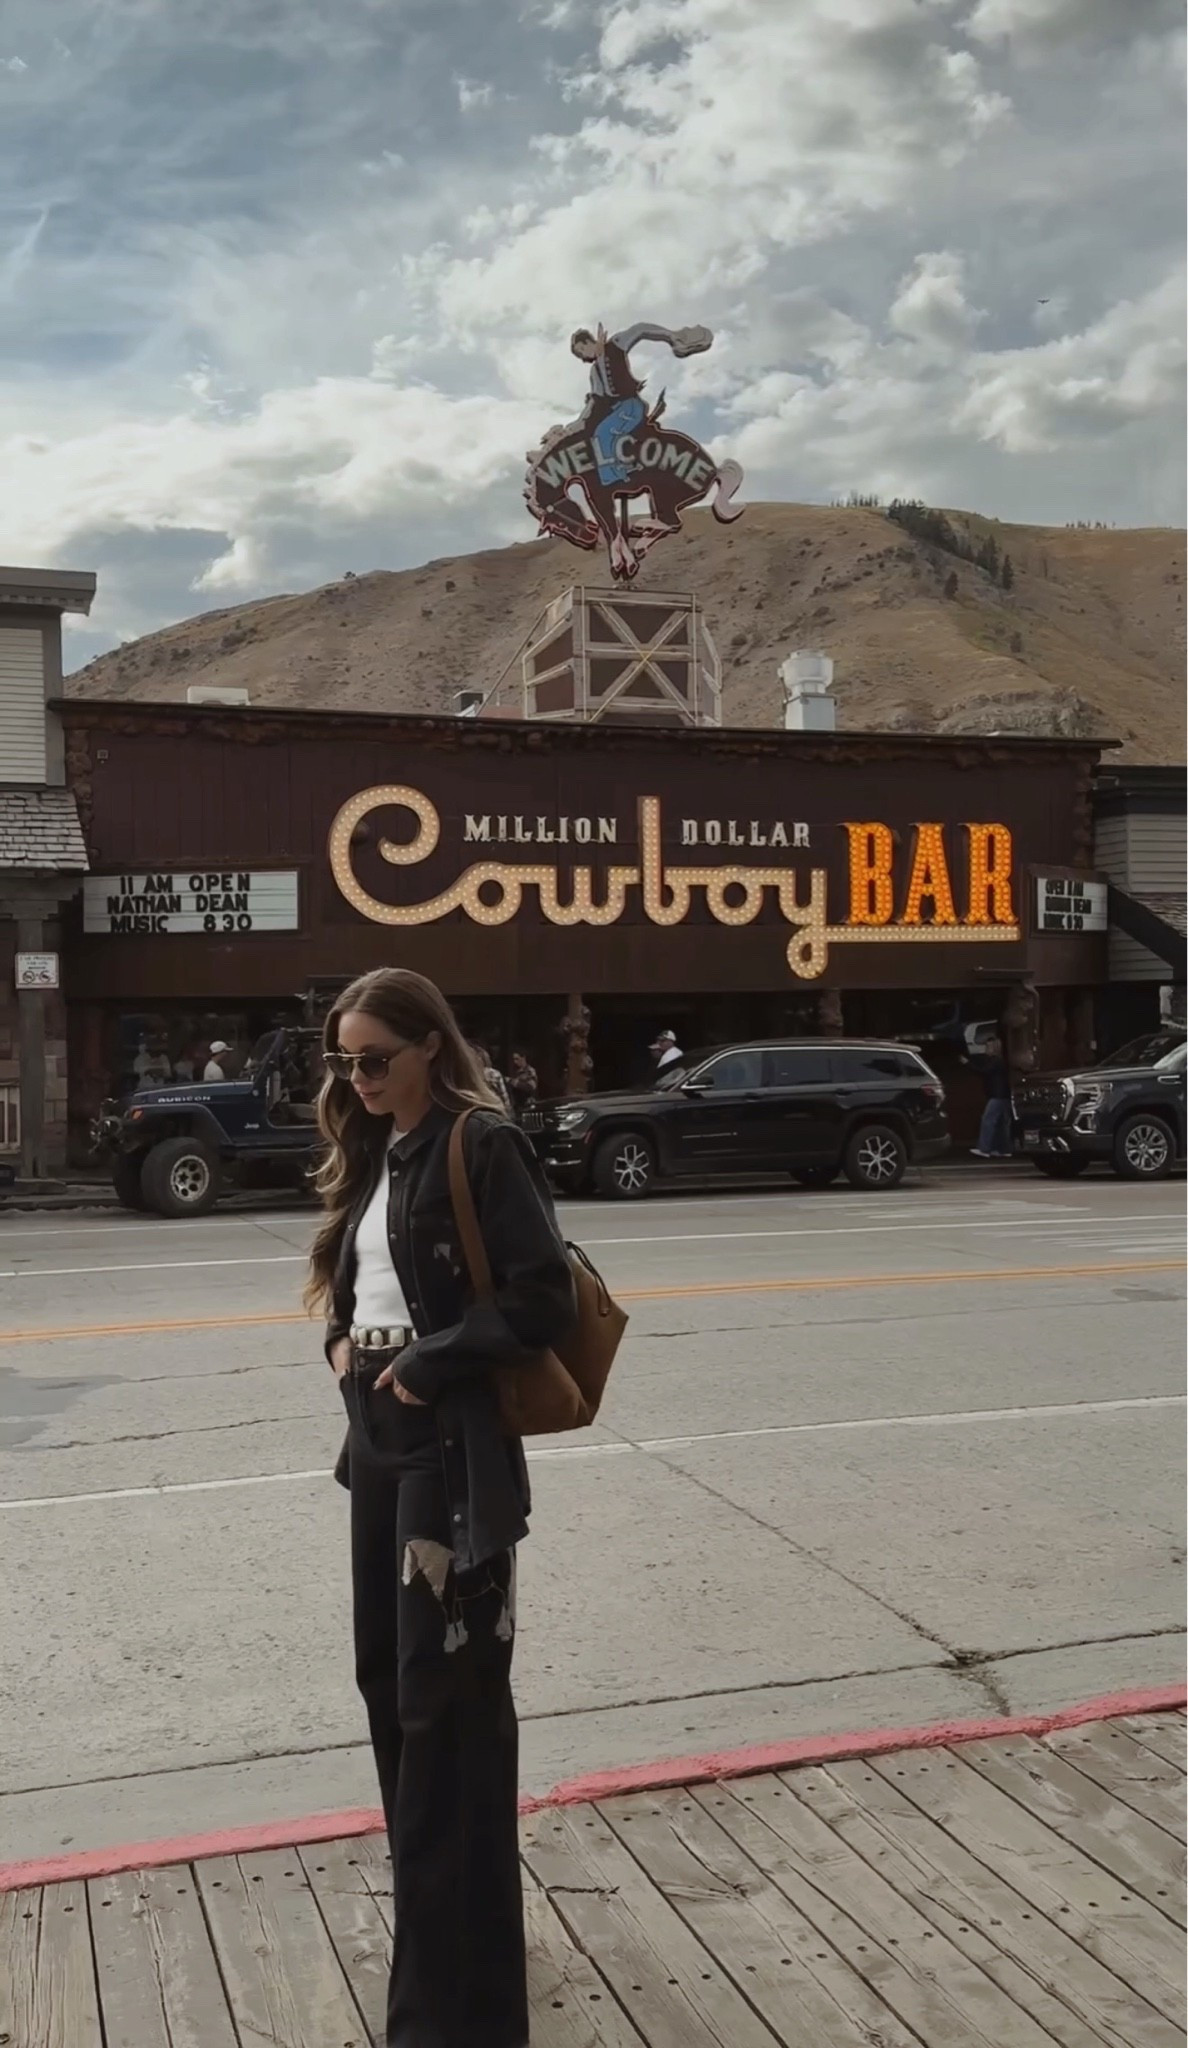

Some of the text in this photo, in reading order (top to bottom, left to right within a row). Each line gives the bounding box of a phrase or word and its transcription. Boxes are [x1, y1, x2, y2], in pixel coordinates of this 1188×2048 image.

[536, 436, 716, 491] WELCOME
[463, 814, 811, 848] MILLION DOLLAR
[143, 875, 173, 893] AM
[189, 874, 251, 892] OPEN
[328, 784, 1018, 979] Cowboy BAR
[107, 893, 248, 914] NATHAN DEAN
[110, 914, 169, 933] MUSIC
